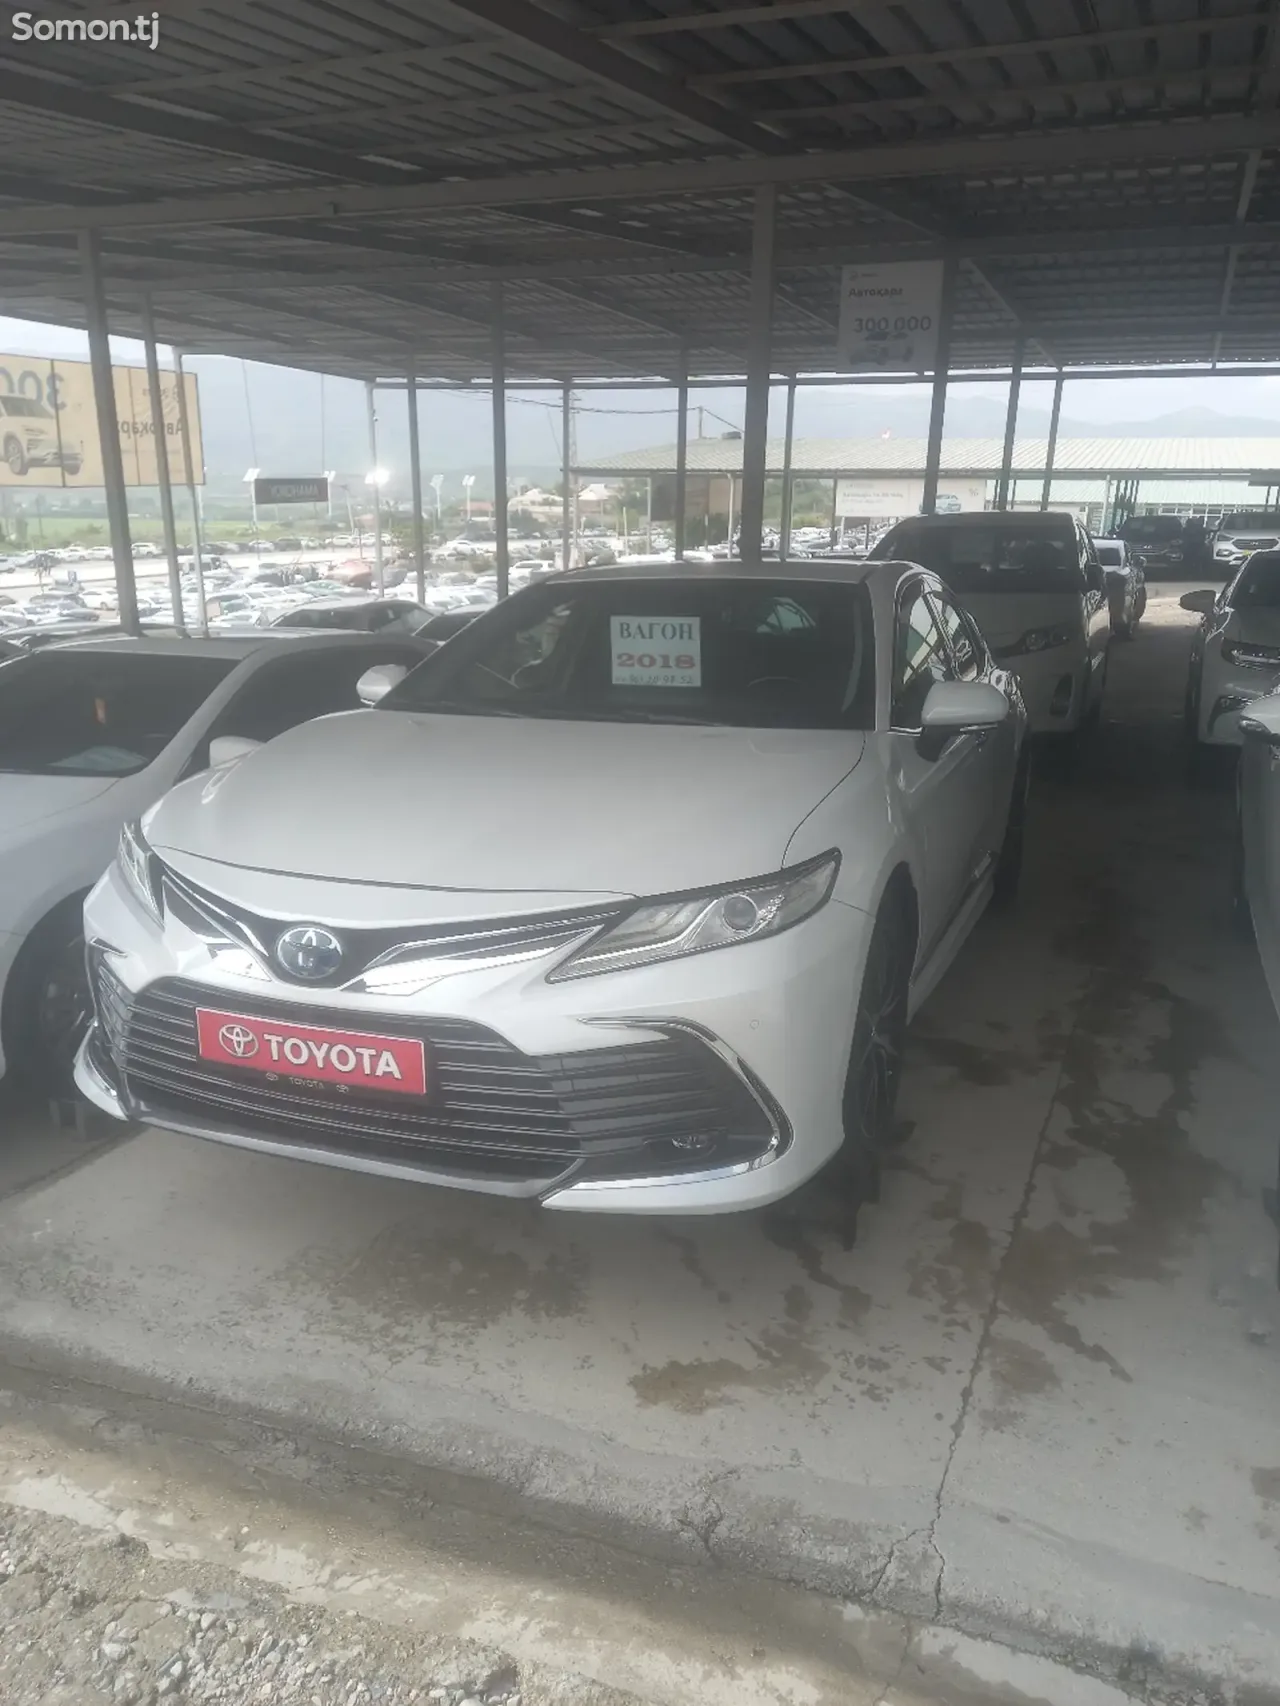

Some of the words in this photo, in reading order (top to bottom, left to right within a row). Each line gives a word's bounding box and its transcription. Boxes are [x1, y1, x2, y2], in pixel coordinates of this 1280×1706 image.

[854, 317, 889, 333] 300
[894, 316, 932, 331] 000
[620, 622, 694, 640] ВАГОН
[617, 653, 695, 669] 2018
[263, 1034, 402, 1080] TOYOTA
[288, 1077, 326, 1090] TOYOTA
